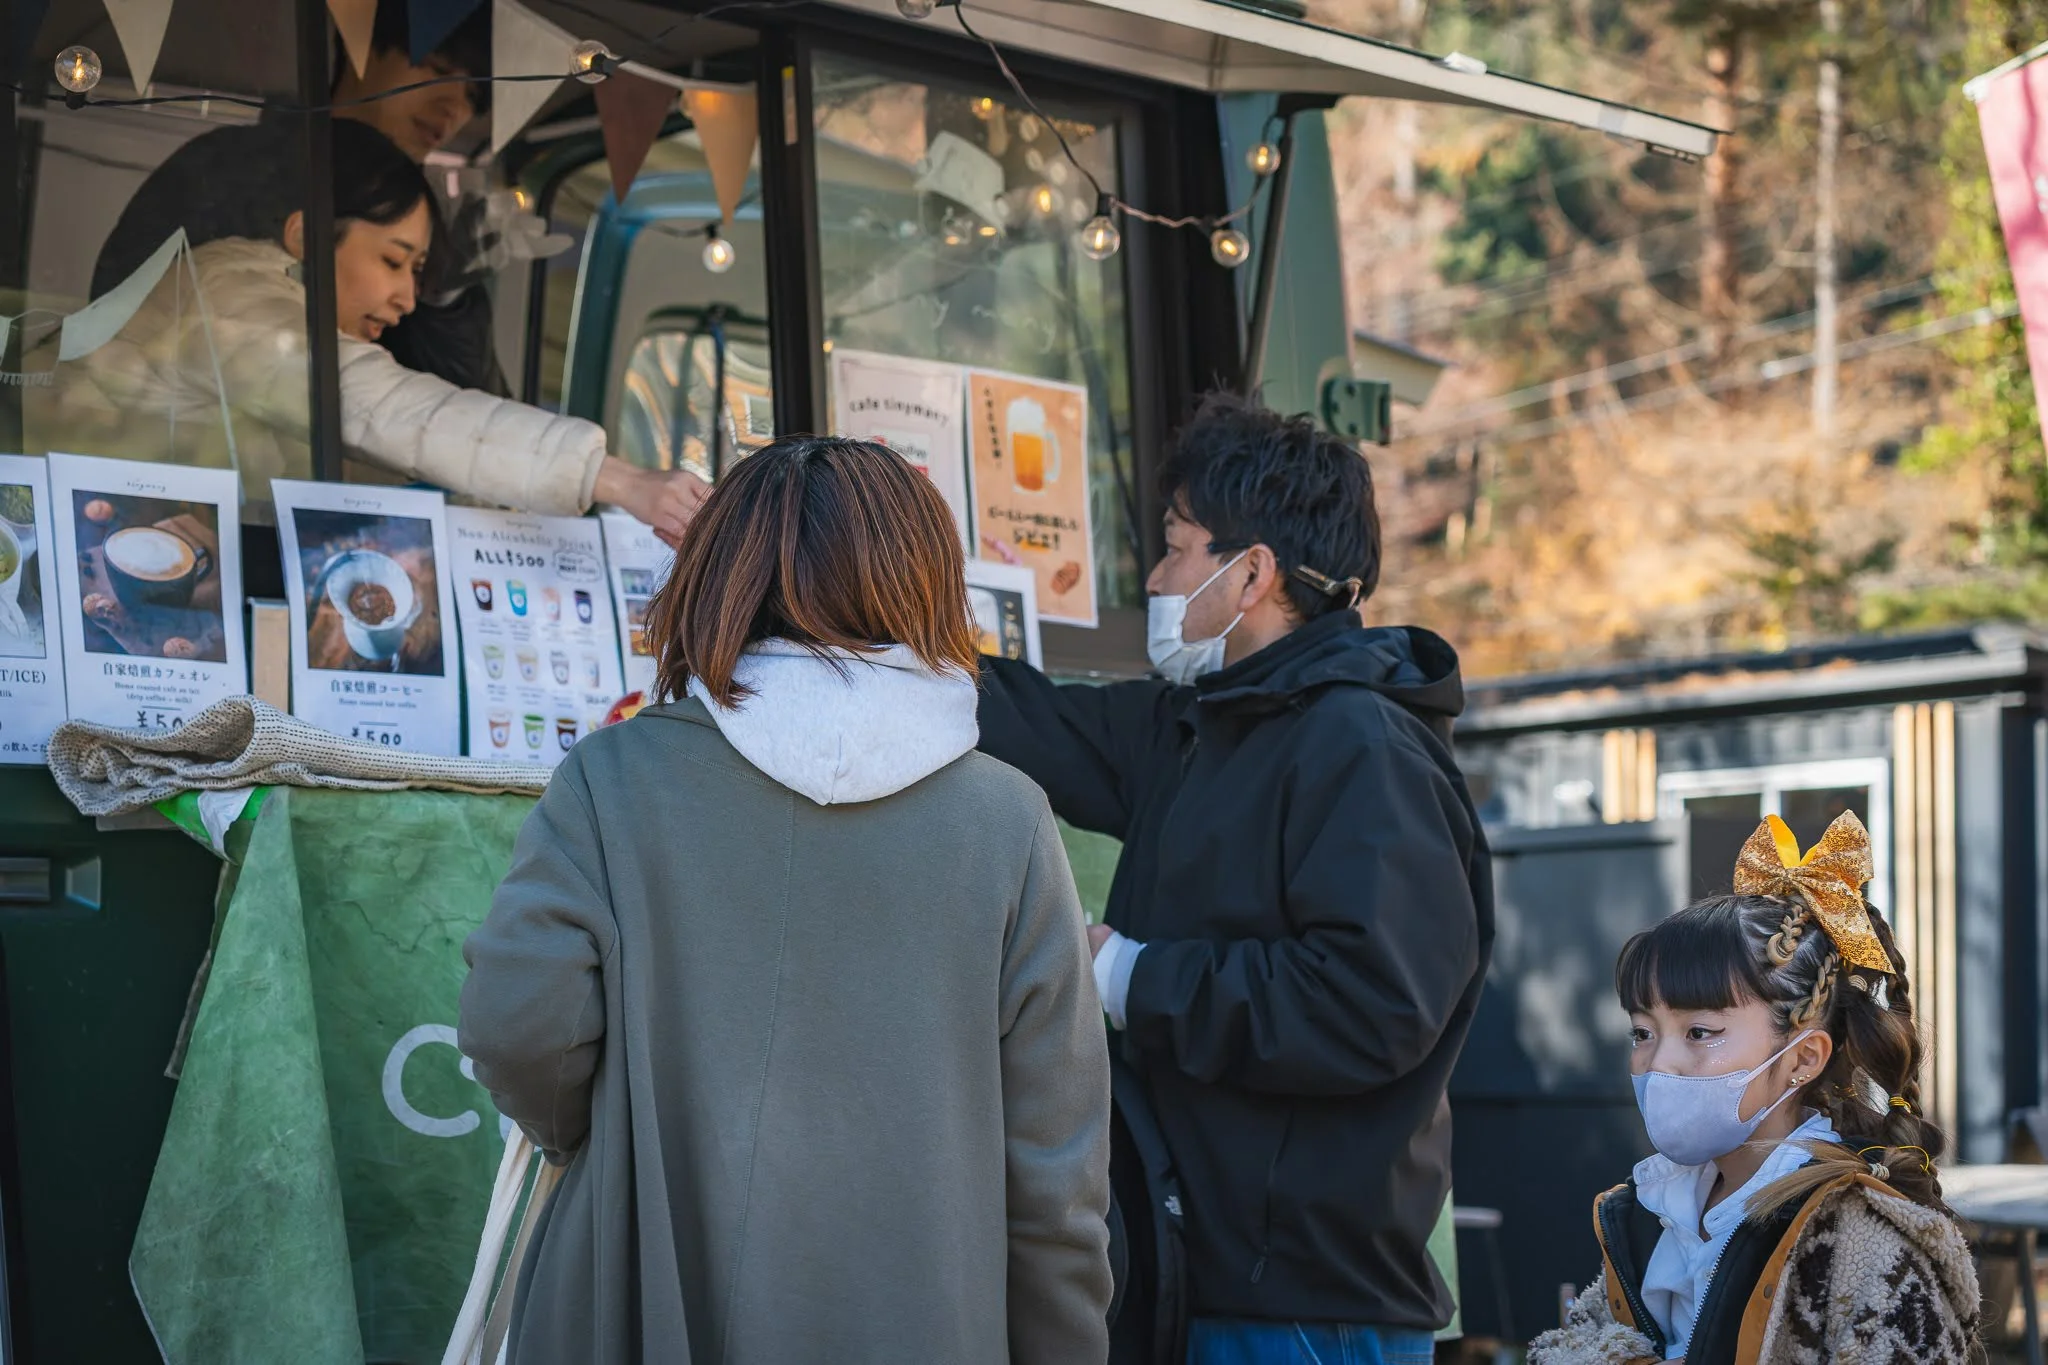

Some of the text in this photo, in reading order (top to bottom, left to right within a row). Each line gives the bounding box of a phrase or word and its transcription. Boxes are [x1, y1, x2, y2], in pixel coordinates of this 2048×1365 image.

[103, 662, 211, 681] 自家焙煎カフェオレ
[331, 679, 423, 696] 自家焙煎コーヒー
